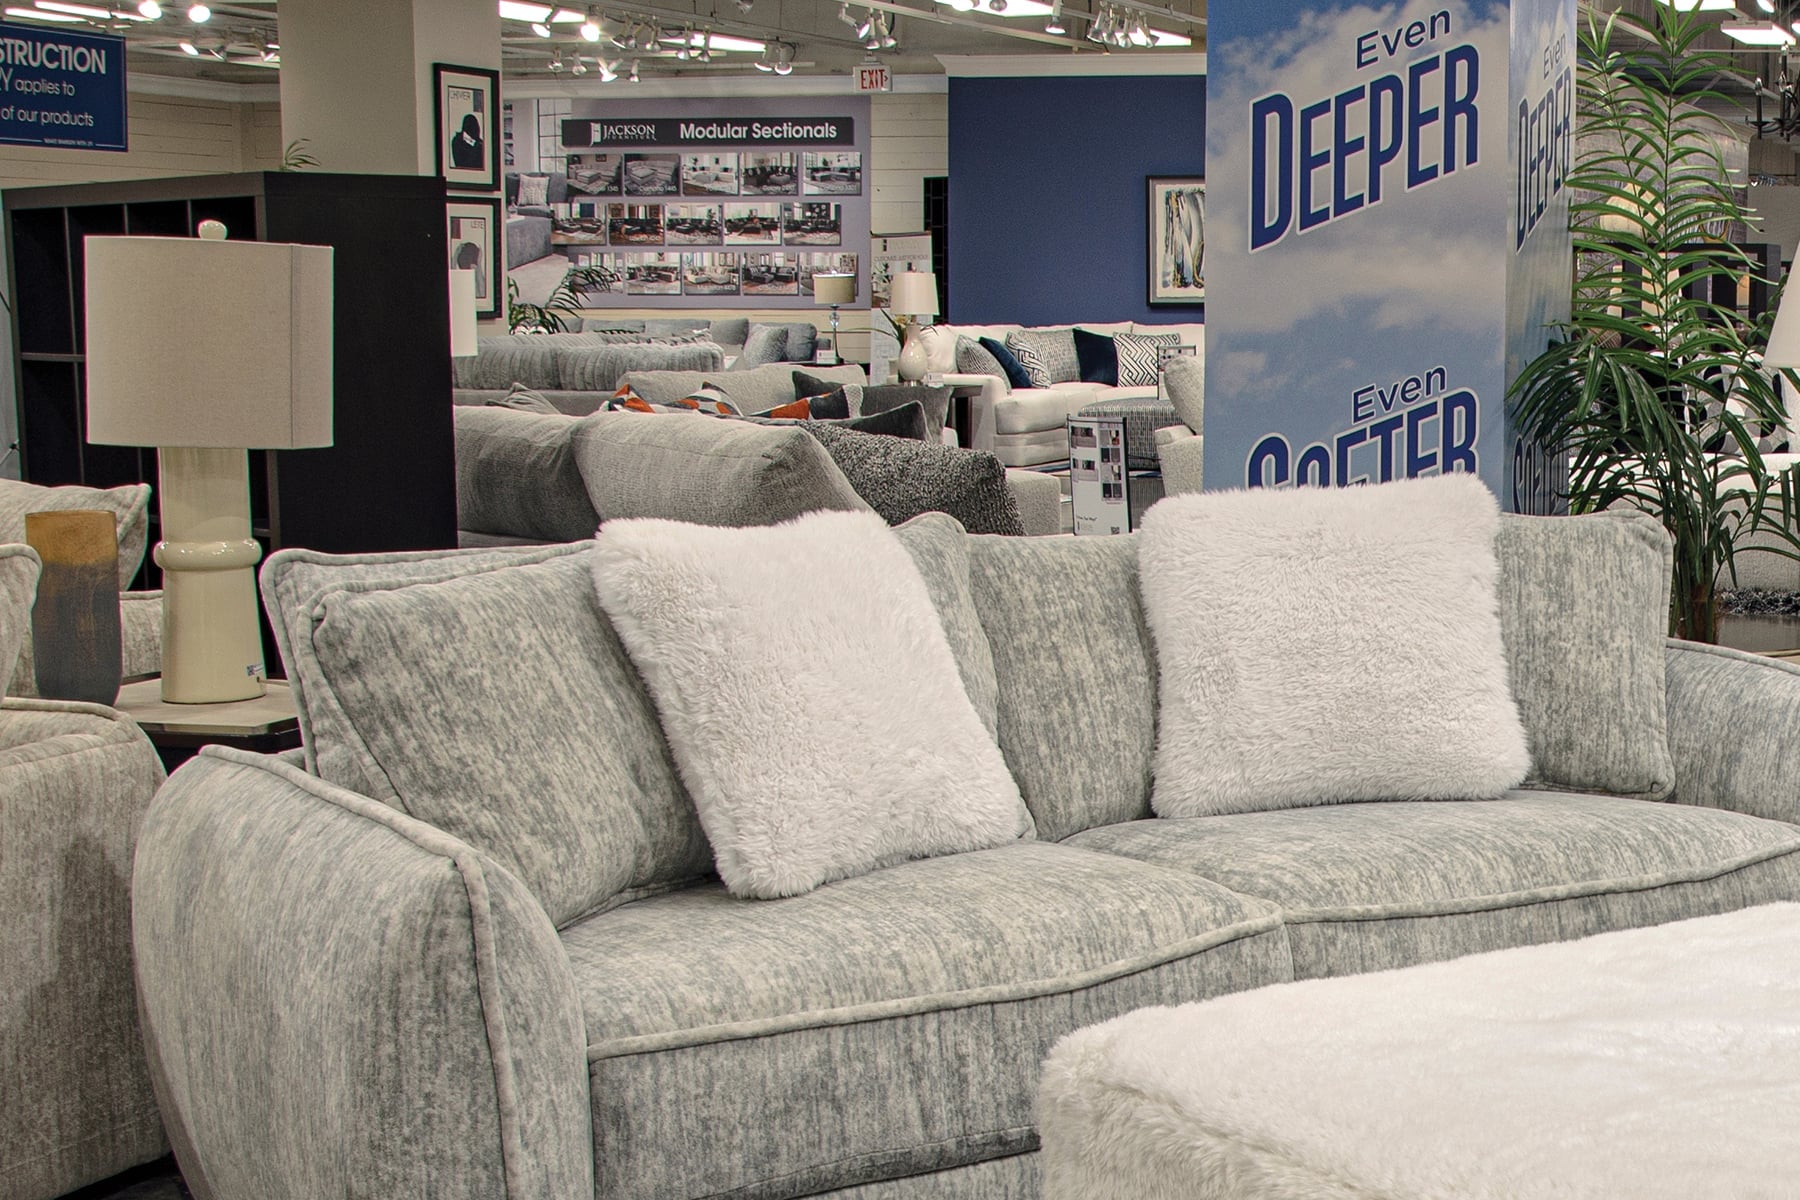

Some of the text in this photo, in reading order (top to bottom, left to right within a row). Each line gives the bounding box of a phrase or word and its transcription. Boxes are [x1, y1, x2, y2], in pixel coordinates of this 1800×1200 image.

[1355, 9, 1451, 70] Even
[1543, 33, 1566, 80] Even
[15, 79, 60, 96] applies
[63, 80, 76, 96] to
[861, 69, 885, 90] EXIT
[1, 106, 94, 127] of our products
[603, 121, 838, 140] JACKSON Modular Sectionals
[1249, 43, 1480, 252] DEEPER
[1516, 65, 1572, 255] DEEPER
[1353, 367, 1446, 424] Even
